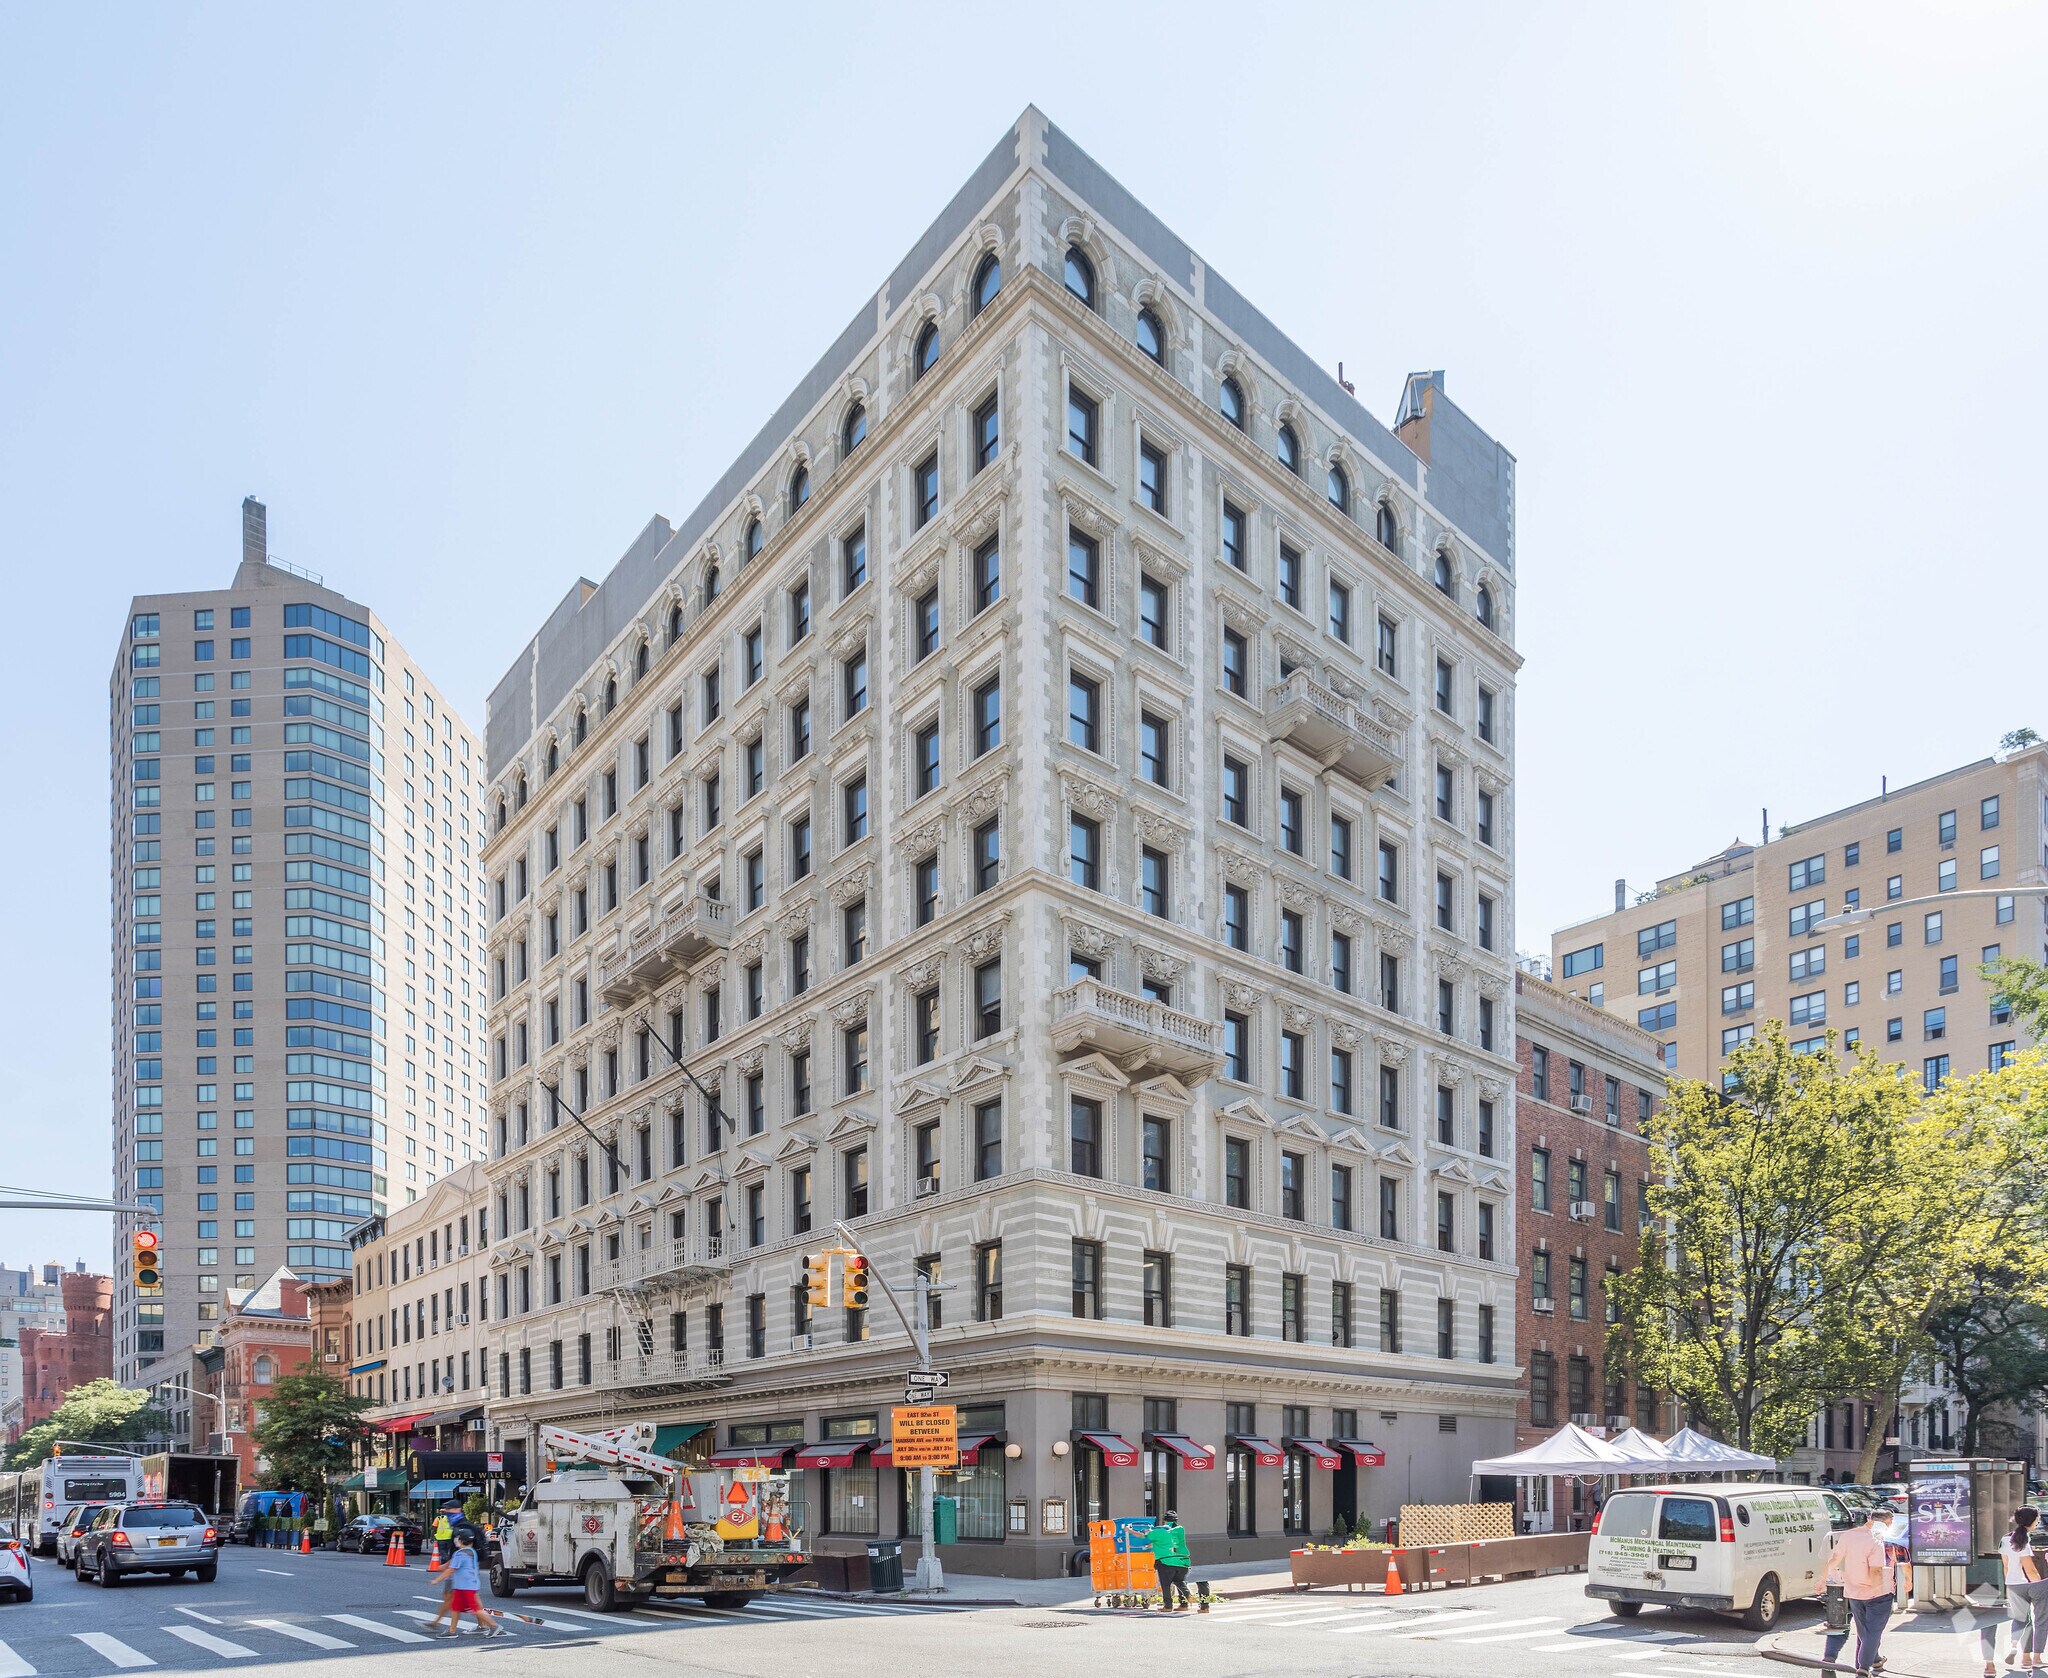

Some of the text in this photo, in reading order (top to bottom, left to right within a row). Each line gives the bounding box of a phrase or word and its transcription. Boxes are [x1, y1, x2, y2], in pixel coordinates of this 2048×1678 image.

[1769, 1524, 1814, 1535] (718) 945-3966
[1635, 1538, 1664, 1547] MECHANICAL
[1666, 1540, 1702, 1549] MAINTENANCE
